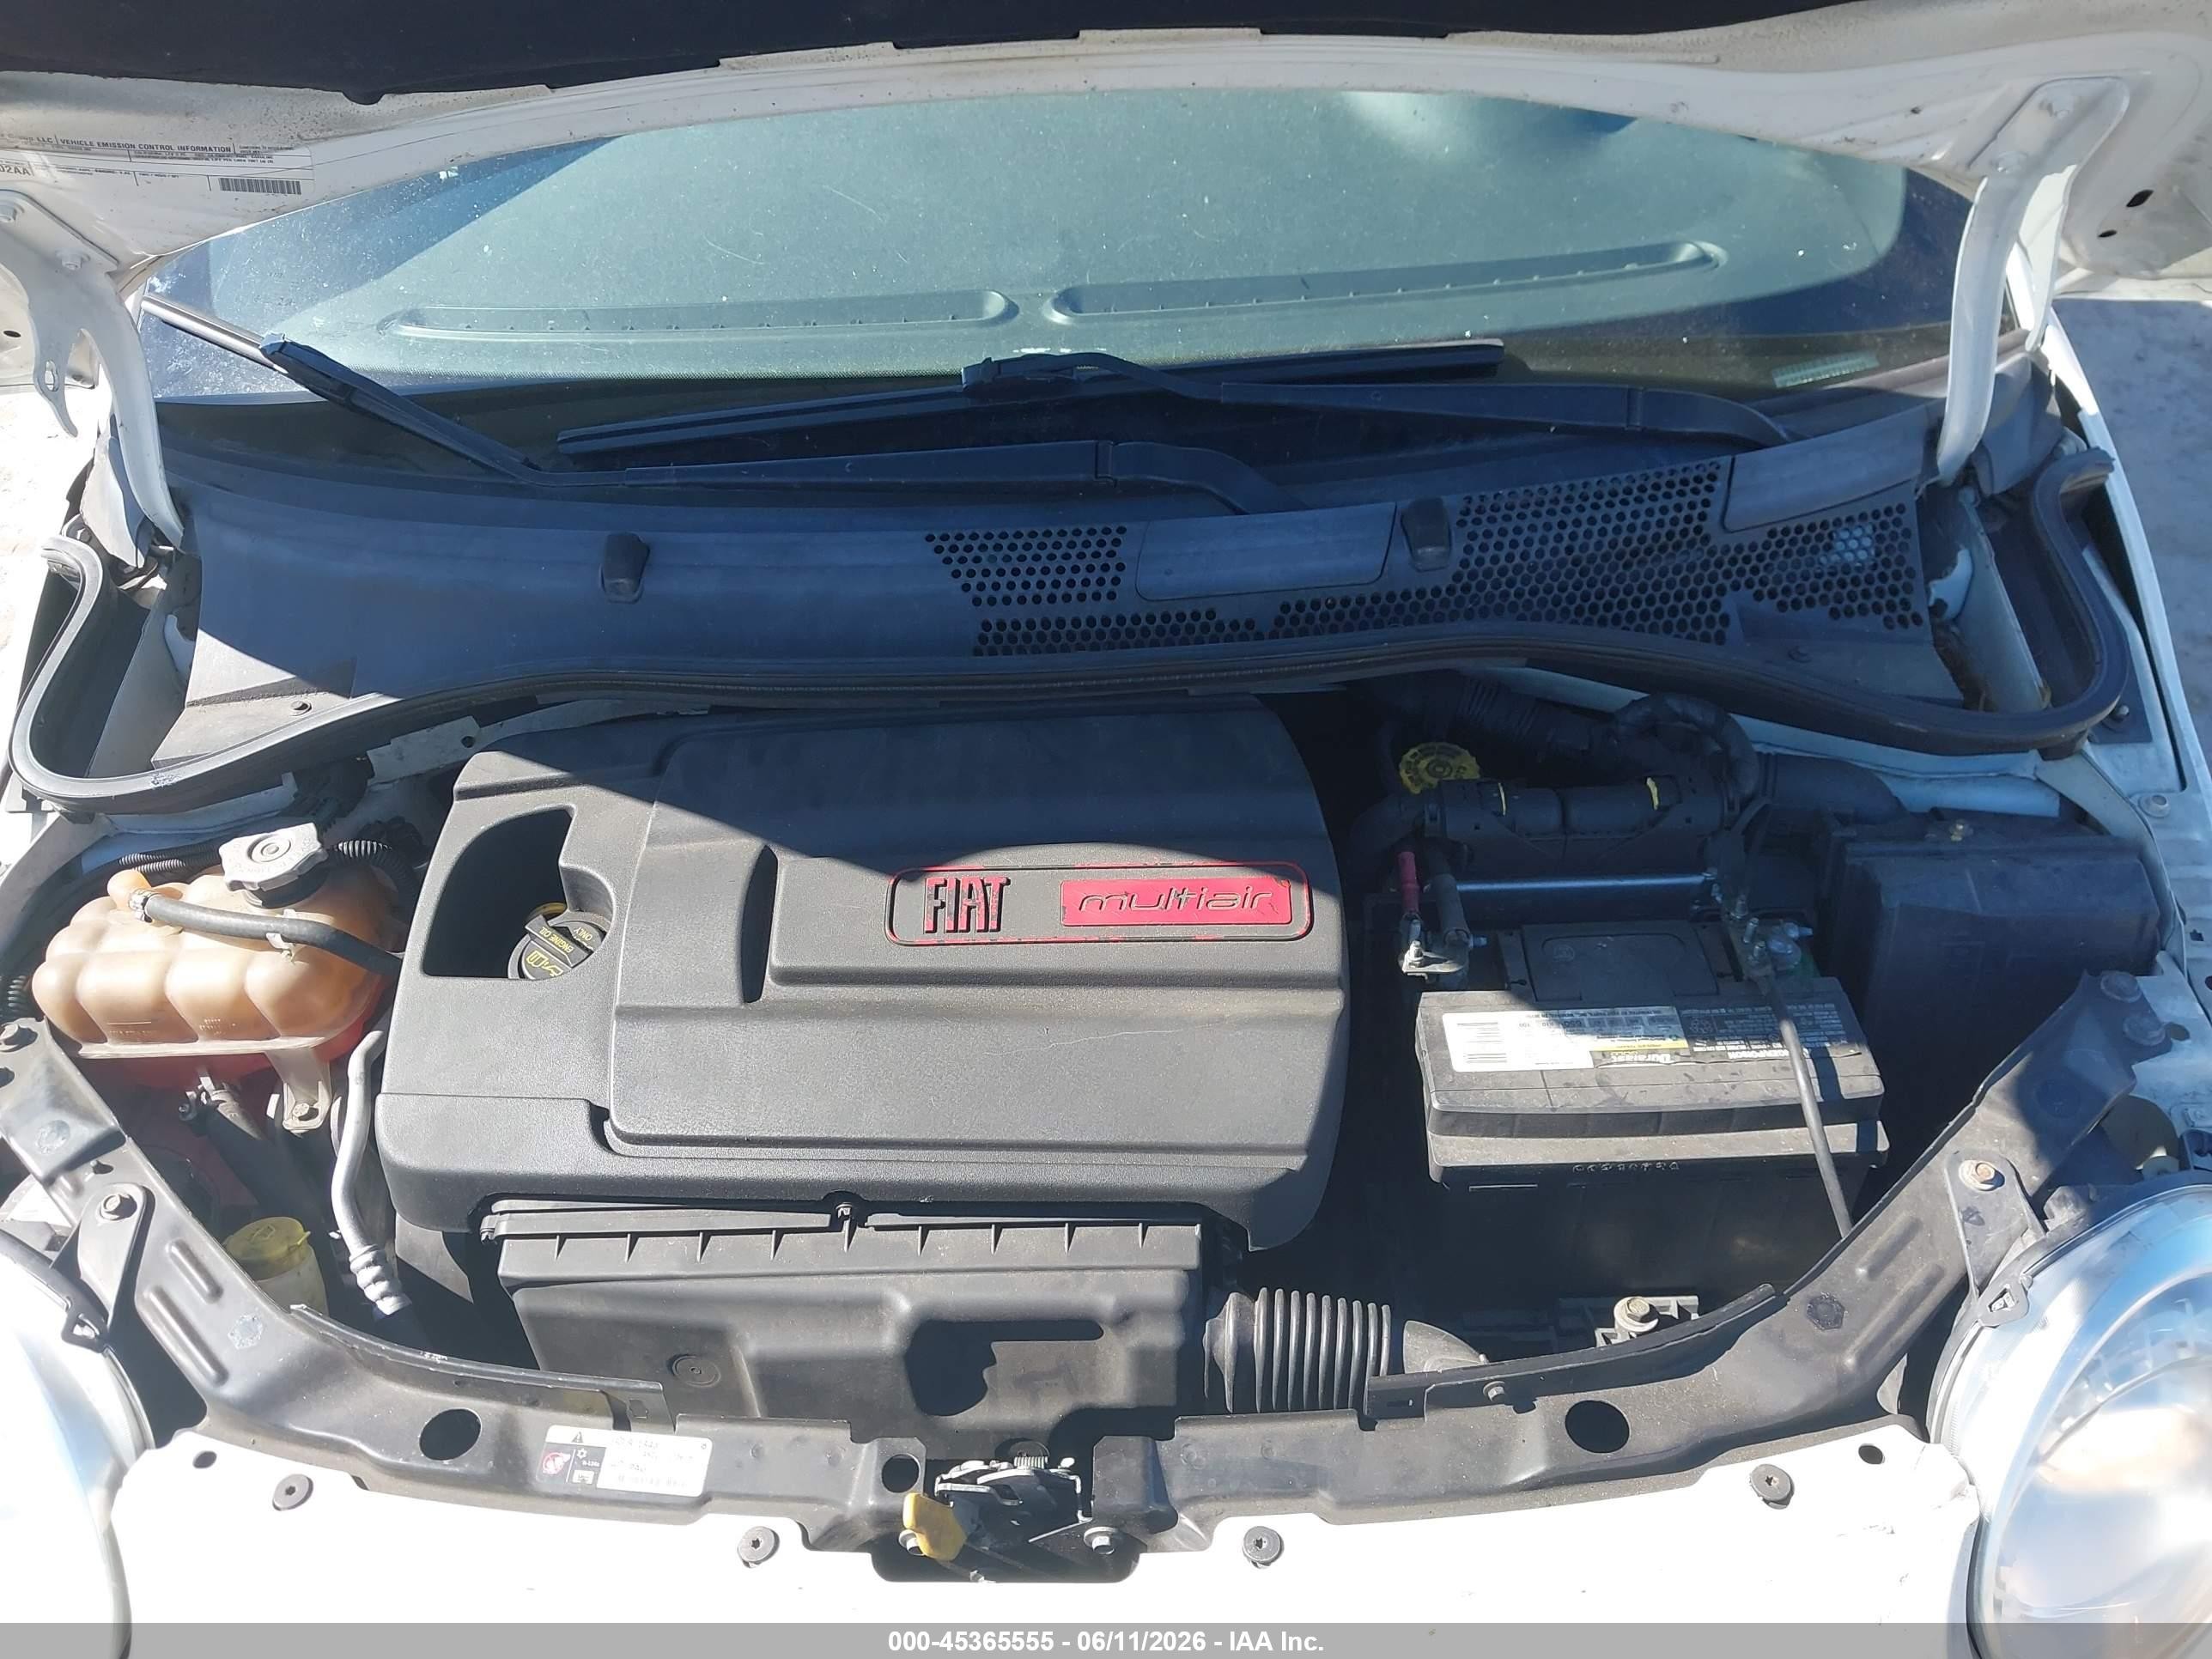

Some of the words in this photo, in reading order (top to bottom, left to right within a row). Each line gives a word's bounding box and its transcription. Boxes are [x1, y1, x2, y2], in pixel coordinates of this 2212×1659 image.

[60, 138, 95, 147] VEHICLE
[97, 141, 136, 149] EMISSION
[924, 877, 1011, 933] FIAT
[1079, 885, 1273, 913] multiair
[538, 927, 551, 938] OIL
[574, 927, 593, 941] ONLY
[550, 933, 574, 953] ENGINE
